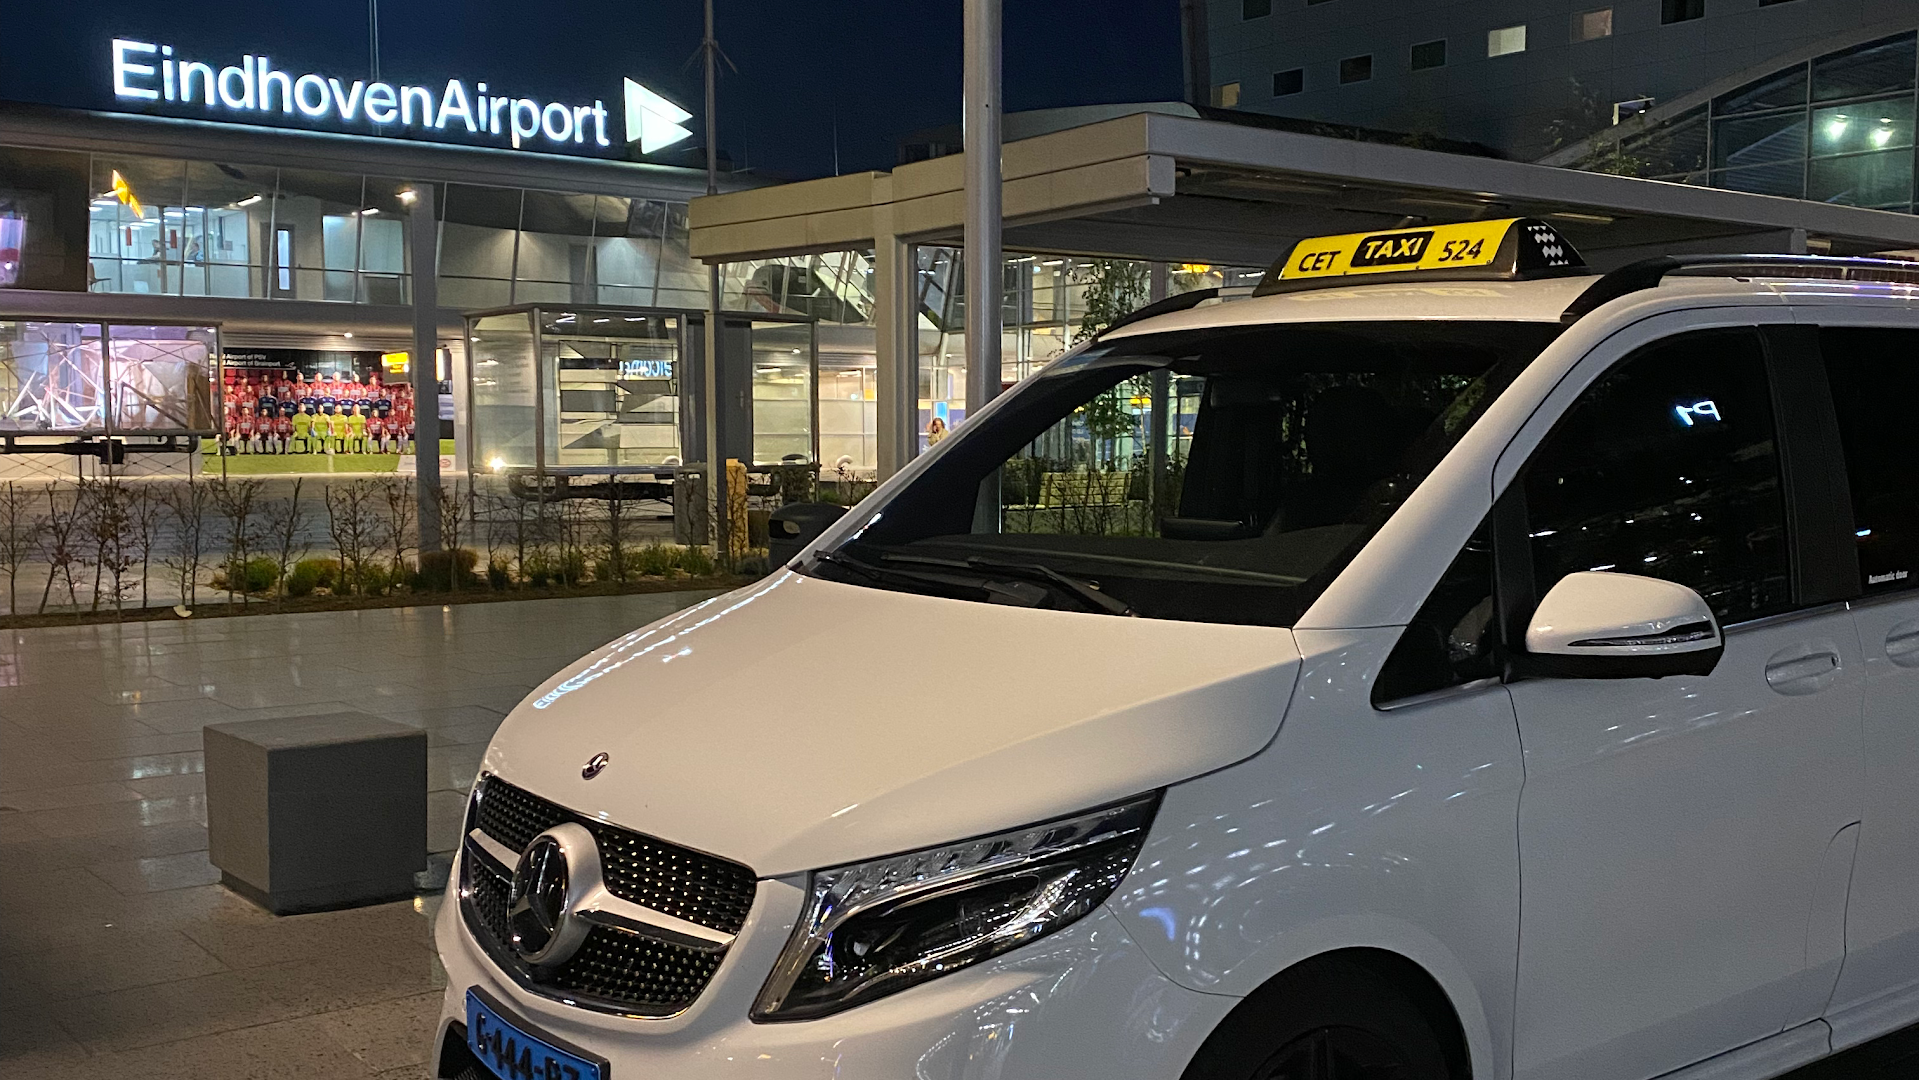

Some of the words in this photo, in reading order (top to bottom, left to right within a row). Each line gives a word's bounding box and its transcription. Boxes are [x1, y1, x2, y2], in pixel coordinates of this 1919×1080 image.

[112, 38, 610, 149] EindhovenAirport
[1298, 250, 1341, 272] CET
[1364, 237, 1425, 260] TAXI
[1438, 238, 1485, 262] 524
